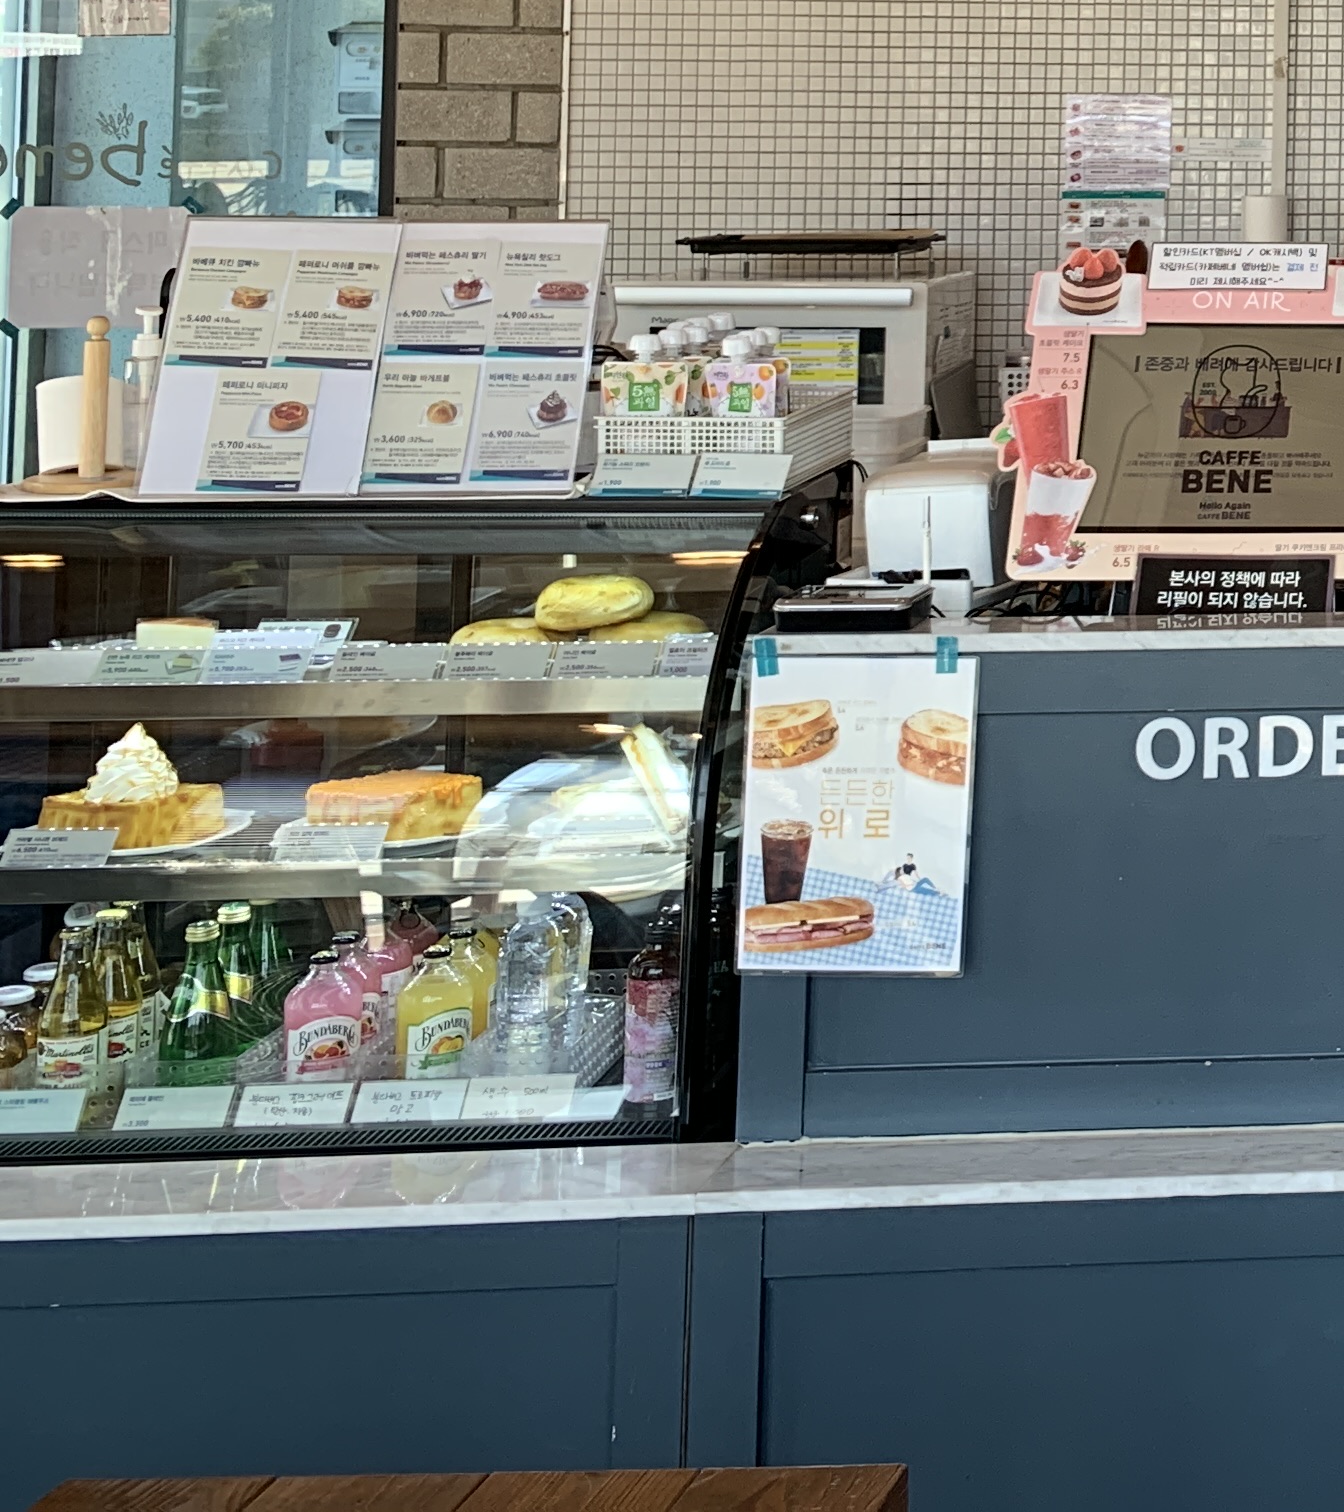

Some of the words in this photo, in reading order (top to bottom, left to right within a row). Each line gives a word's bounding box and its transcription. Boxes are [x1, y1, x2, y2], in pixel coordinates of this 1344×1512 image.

[1193, 291, 1232, 309] ON
[1244, 292, 1291, 311] AIR
[1063, 353, 1080, 362] 7.5
[1145, 357, 1189, 371] 존중과
[1061, 380, 1079, 389] 6.3
[1199, 451, 1262, 465] CAFFE
[1182, 469, 1273, 493] BENE
[1224, 502, 1251, 510] Again
[1221, 512, 1251, 520] BENE
[1112, 557, 1131, 567] 6.5
[1169, 571, 1216, 586] 본사의
[1220, 571, 1265, 587] 정책에
[1270, 571, 1301, 587] 따라
[1157, 592, 1203, 607] 리필이
[1207, 592, 1238, 608] 되지
[1243, 592, 1307, 608] 않습니다.
